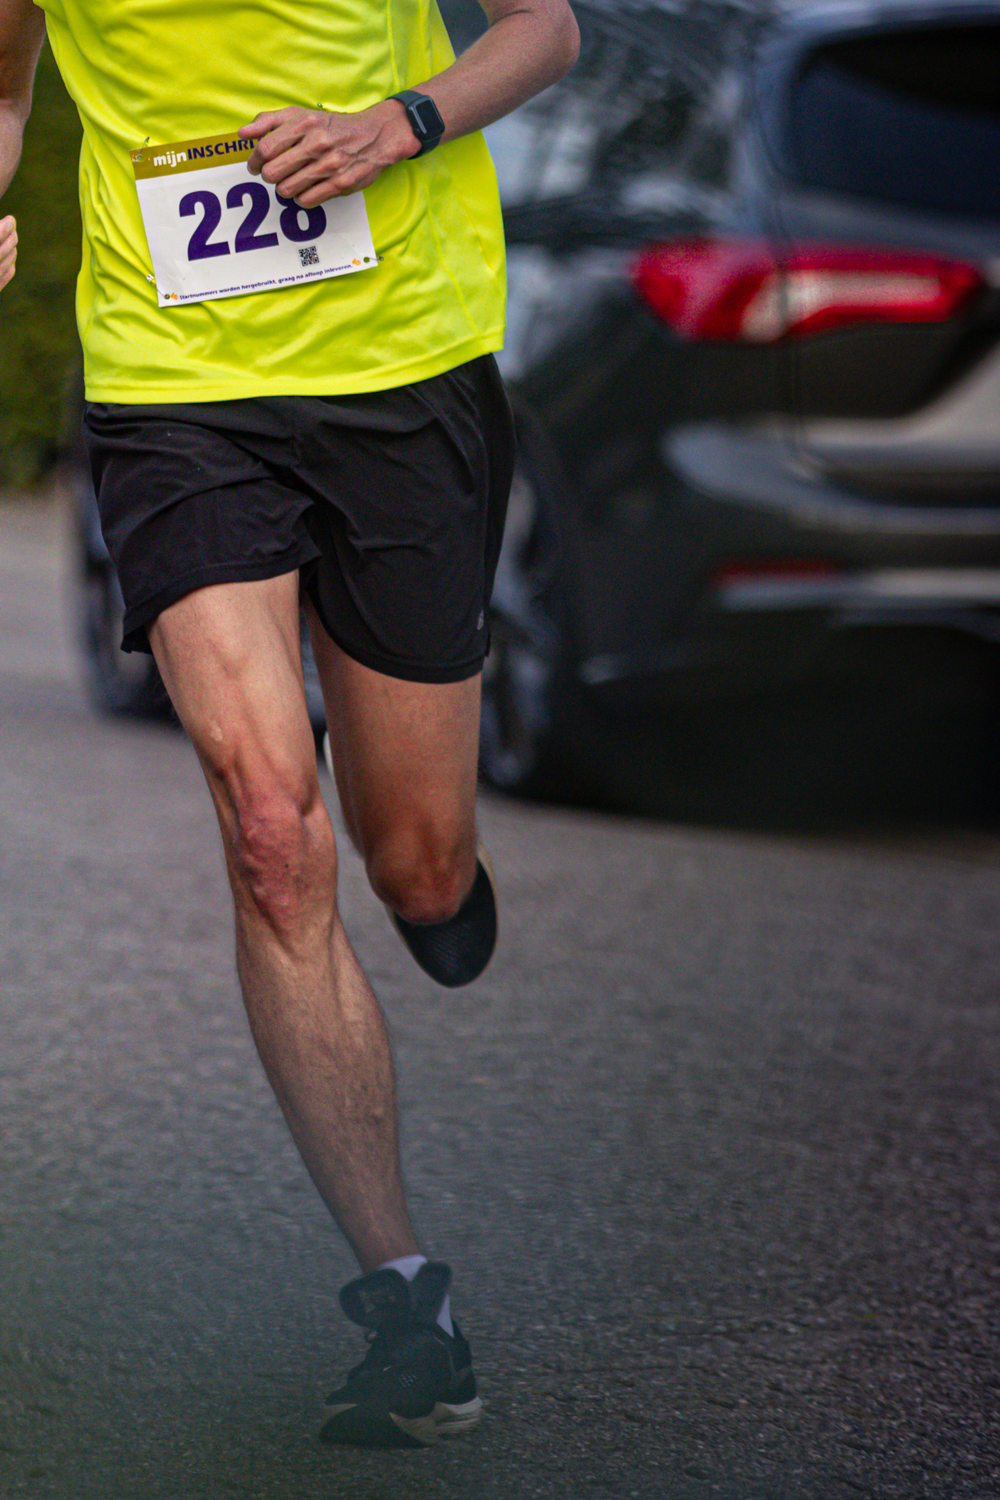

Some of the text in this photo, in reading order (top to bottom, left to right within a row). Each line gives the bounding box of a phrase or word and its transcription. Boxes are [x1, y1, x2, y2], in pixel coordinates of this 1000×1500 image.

[179, 181, 327, 261] 228
[179, 290, 218, 300] Startnummers
[219, 285, 241, 293] worden
[278, 276, 295, 284] graag
[305, 269, 323, 278] afloop
